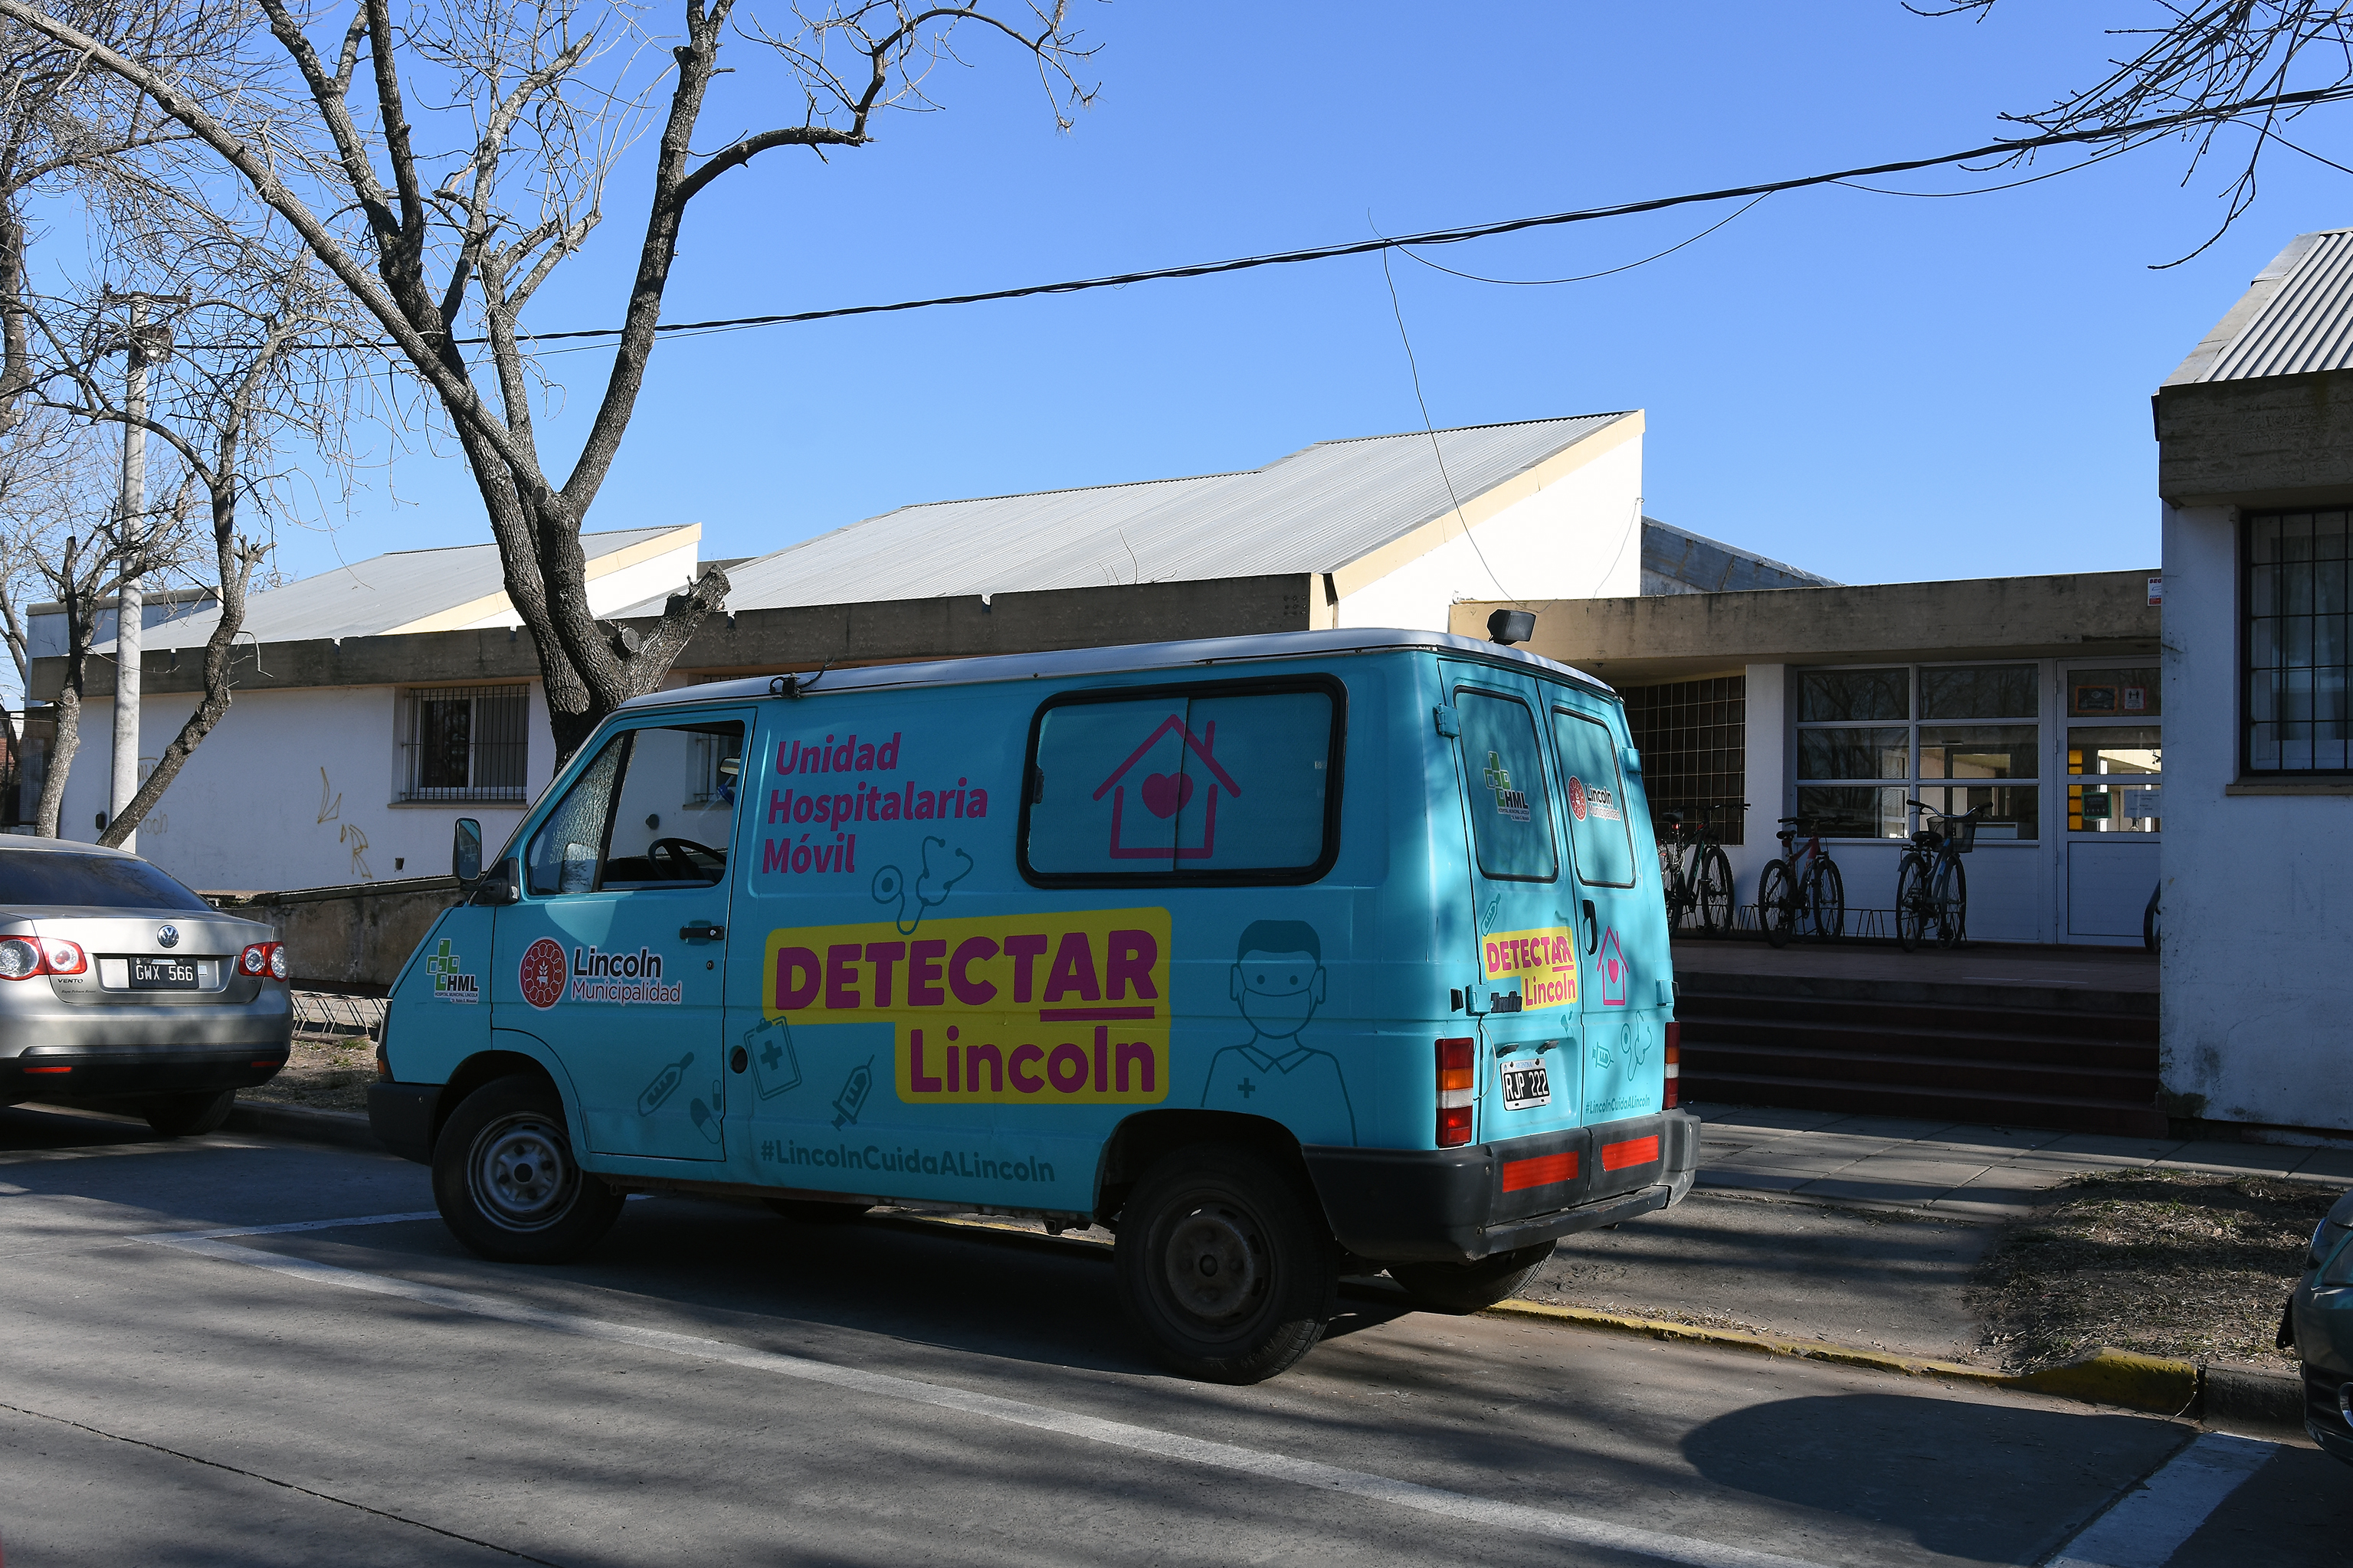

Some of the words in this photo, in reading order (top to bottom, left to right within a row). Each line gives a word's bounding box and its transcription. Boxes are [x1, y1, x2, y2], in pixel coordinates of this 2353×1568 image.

[775, 732, 902, 775] Unidad
[768, 777, 988, 830] Hospitalaria
[1504, 791, 1529, 809] HML
[1585, 784, 1613, 805] Lincoln
[762, 833, 856, 874] Móvil
[574, 948, 661, 978] Lincoln
[775, 928, 1159, 1010] DETECTAR
[1486, 936, 1573, 973] DETECTAR
[136, 965, 160, 980] GWX
[169, 965, 194, 981] 566
[447, 975, 478, 992] HML
[572, 980, 681, 1003] Municipalidad
[1525, 973, 1576, 1007] Lincoln
[910, 1025, 1155, 1094] Lincoln
[1504, 1072, 1525, 1100] RJP
[1529, 1070, 1549, 1096] 222
[1585, 1095, 1650, 1114] #LincolnCuidaALincoln
[761, 1140, 1056, 1182] #LincolnCuidaALincoln
